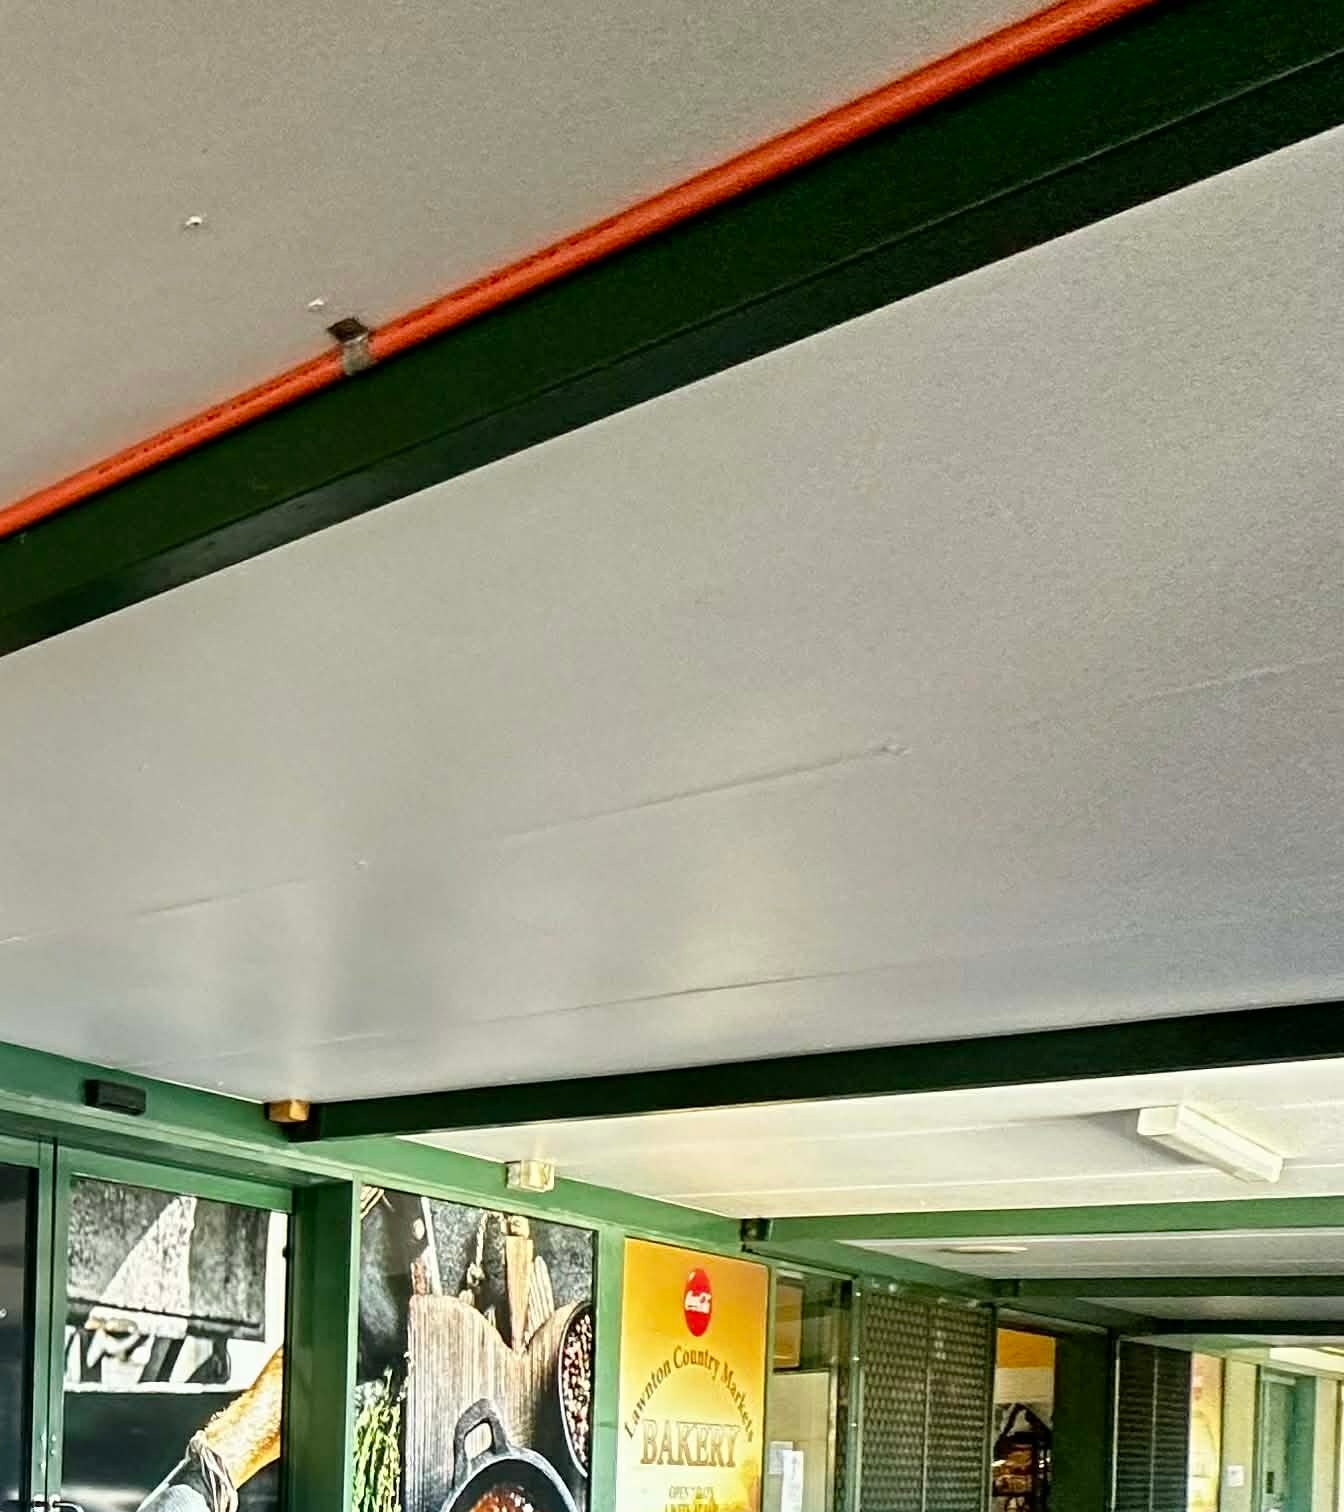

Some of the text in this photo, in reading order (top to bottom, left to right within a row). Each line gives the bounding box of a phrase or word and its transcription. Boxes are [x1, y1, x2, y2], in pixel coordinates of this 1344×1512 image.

[624, 1358, 672, 1440] Lawnton
[673, 1344, 720, 1381] Country
[639, 1418, 741, 1468] BAKERY
